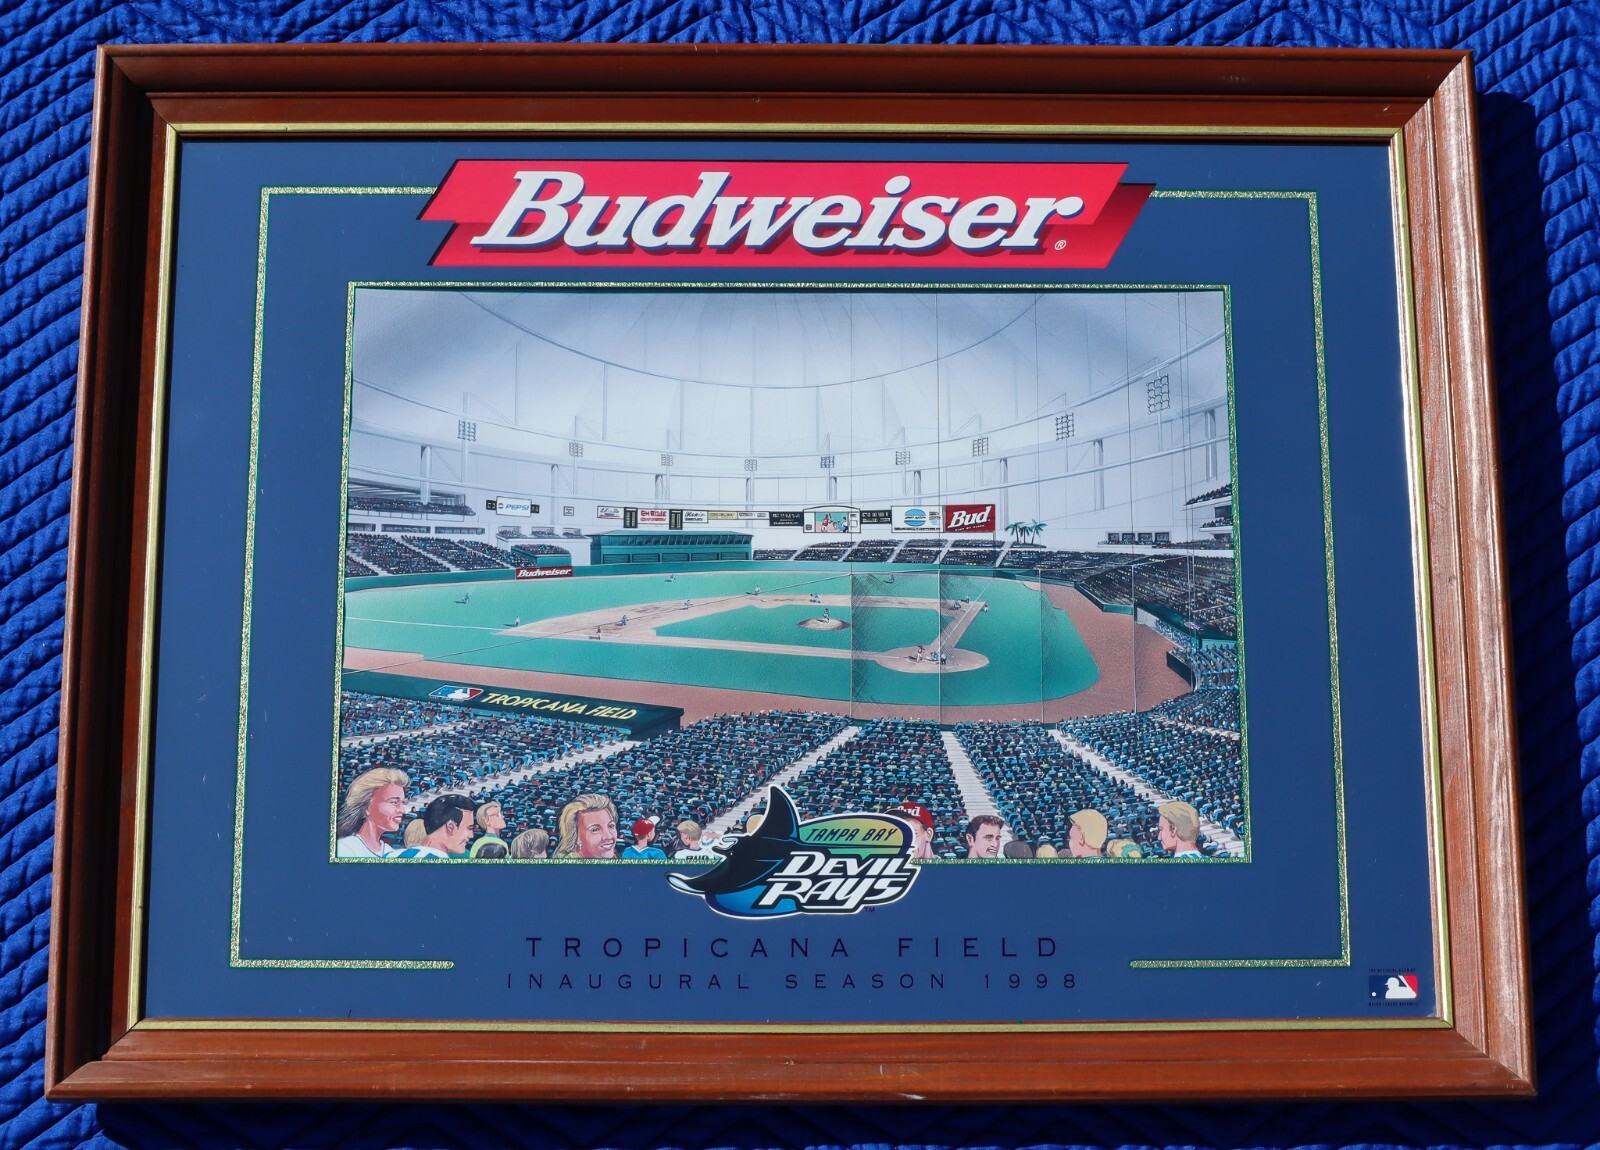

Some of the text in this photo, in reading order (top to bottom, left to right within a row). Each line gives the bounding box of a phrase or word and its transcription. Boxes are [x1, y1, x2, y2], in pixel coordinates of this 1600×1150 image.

[471, 171, 1084, 251] Budweiser
[505, 503, 530, 511] PEPSI
[947, 506, 992, 529] Bud
[517, 568, 572, 578] Budweiser
[481, 692, 638, 720] TROPICANA FIELD
[805, 828, 899, 842] TAMPA BAY
[773, 851, 911, 876] DEVIL
[526, 938, 1057, 958] TROPICANA FIELD
[507, 973, 1076, 990] INAUGURAL SEASON 1998
